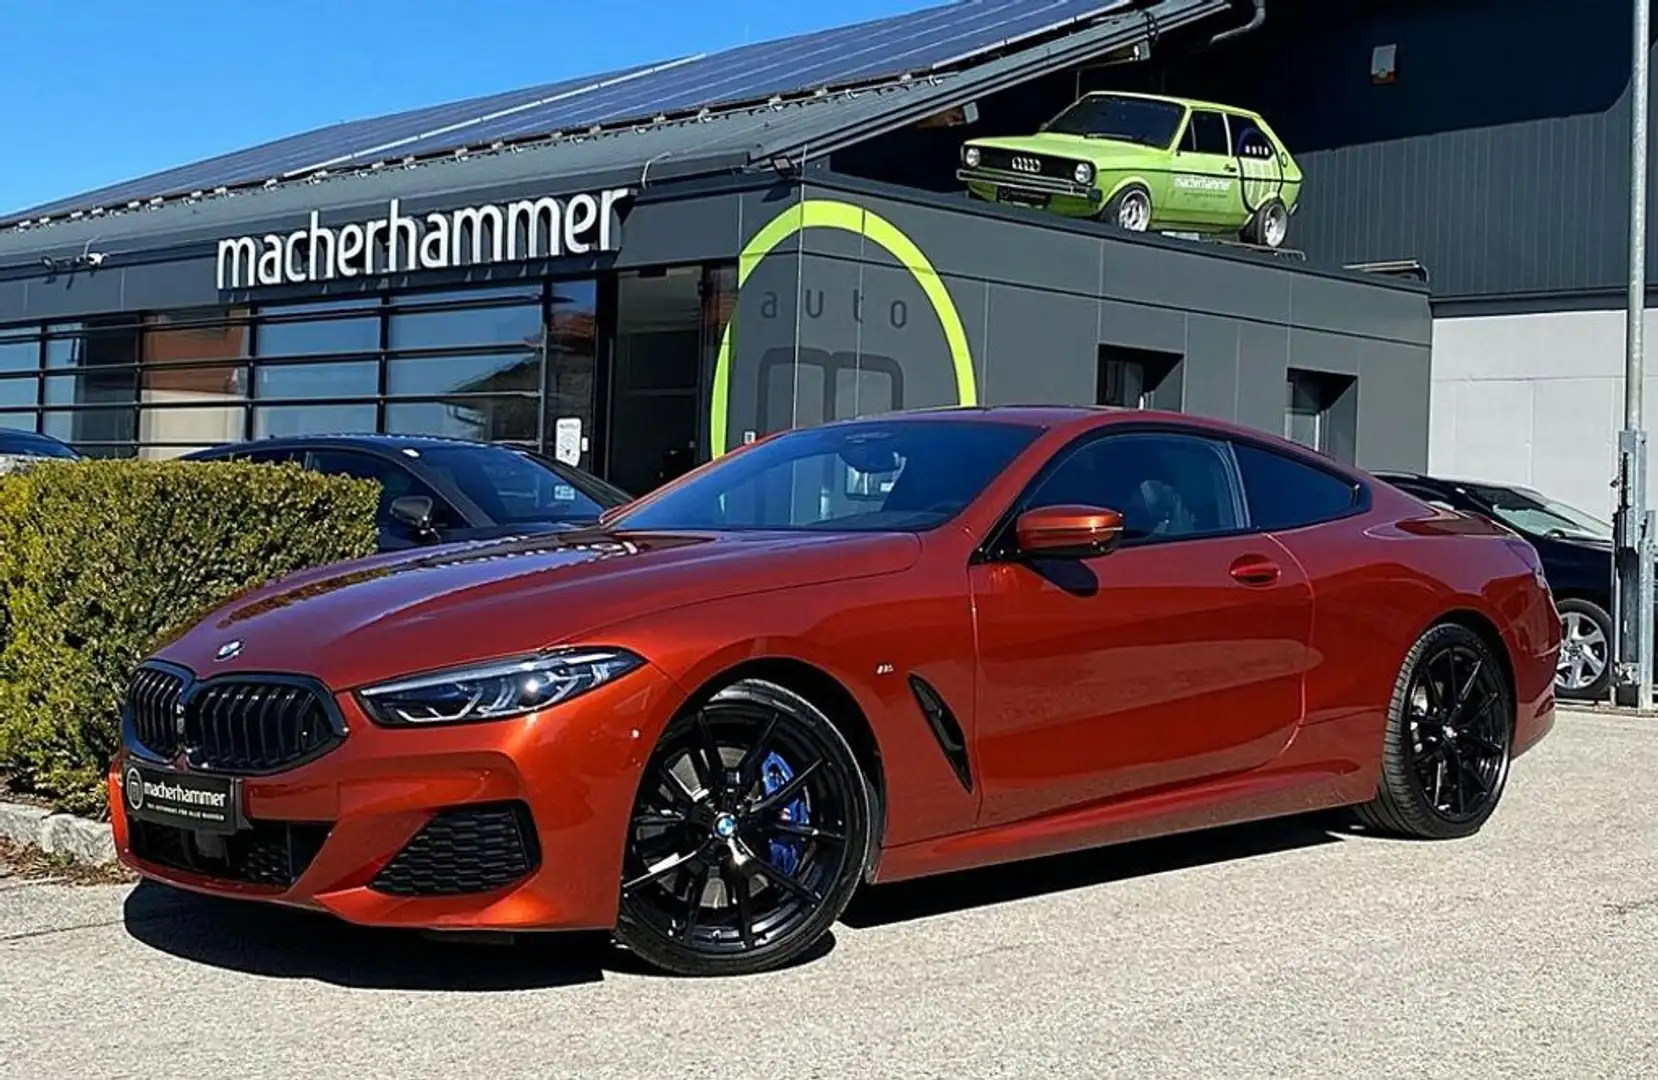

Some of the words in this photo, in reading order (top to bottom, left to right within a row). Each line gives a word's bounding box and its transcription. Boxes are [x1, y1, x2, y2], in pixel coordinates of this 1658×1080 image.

[216, 188, 631, 289] macherhammer
[760, 288, 908, 329] auto
[143, 781, 226, 807] macherhammer
